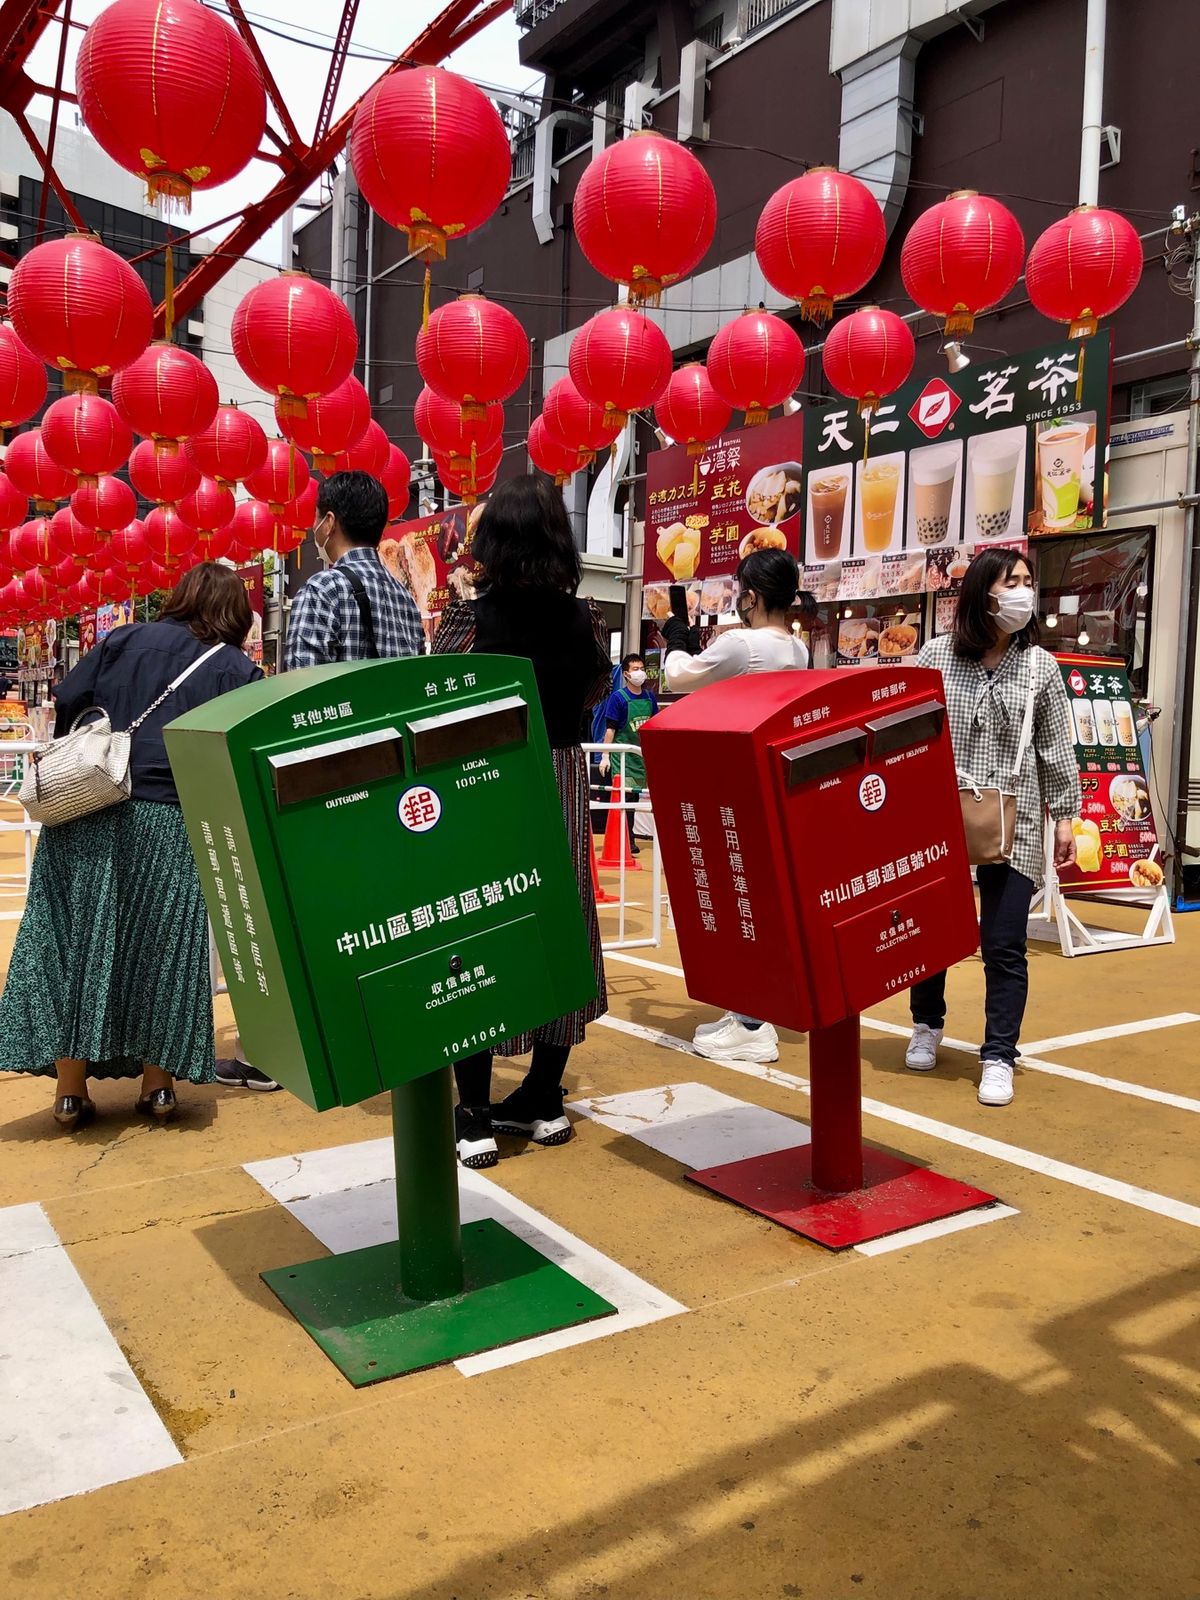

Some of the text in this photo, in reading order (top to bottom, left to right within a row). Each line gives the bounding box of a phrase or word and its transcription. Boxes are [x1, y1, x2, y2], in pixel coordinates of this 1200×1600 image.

[818, 353, 1080, 452] 天仁 茗茶
[1025, 402, 1082, 422] SINCE 1953
[711, 480, 743, 501] 豆花
[709, 524, 739, 544] 芋圓
[424, 672, 477, 697] 台北市
[871, 681, 907, 702] 限時郵件
[1089, 673, 1123, 695] 茗茶
[291, 701, 354, 729] 其他地區
[793, 705, 831, 728] 航空郵件
[462, 758, 489, 771] LOCAL
[885, 744, 929, 767] PROMPT DELIVERY
[455, 769, 500, 790] 100-116
[819, 777, 842, 790] AIRMAIL
[325, 790, 369, 809] OUTGOING
[1100, 819, 1125, 832] 豆花
[1104, 844, 1129, 858] 芋圓
[719, 806, 756, 942] 請用標準信封
[875, 926, 921, 953] COLLECTING TIME
[885, 963, 926, 991] 1042064
[425, 975, 497, 1010] COLLECTING TIME
[442, 1022, 506, 1057] 1041064
